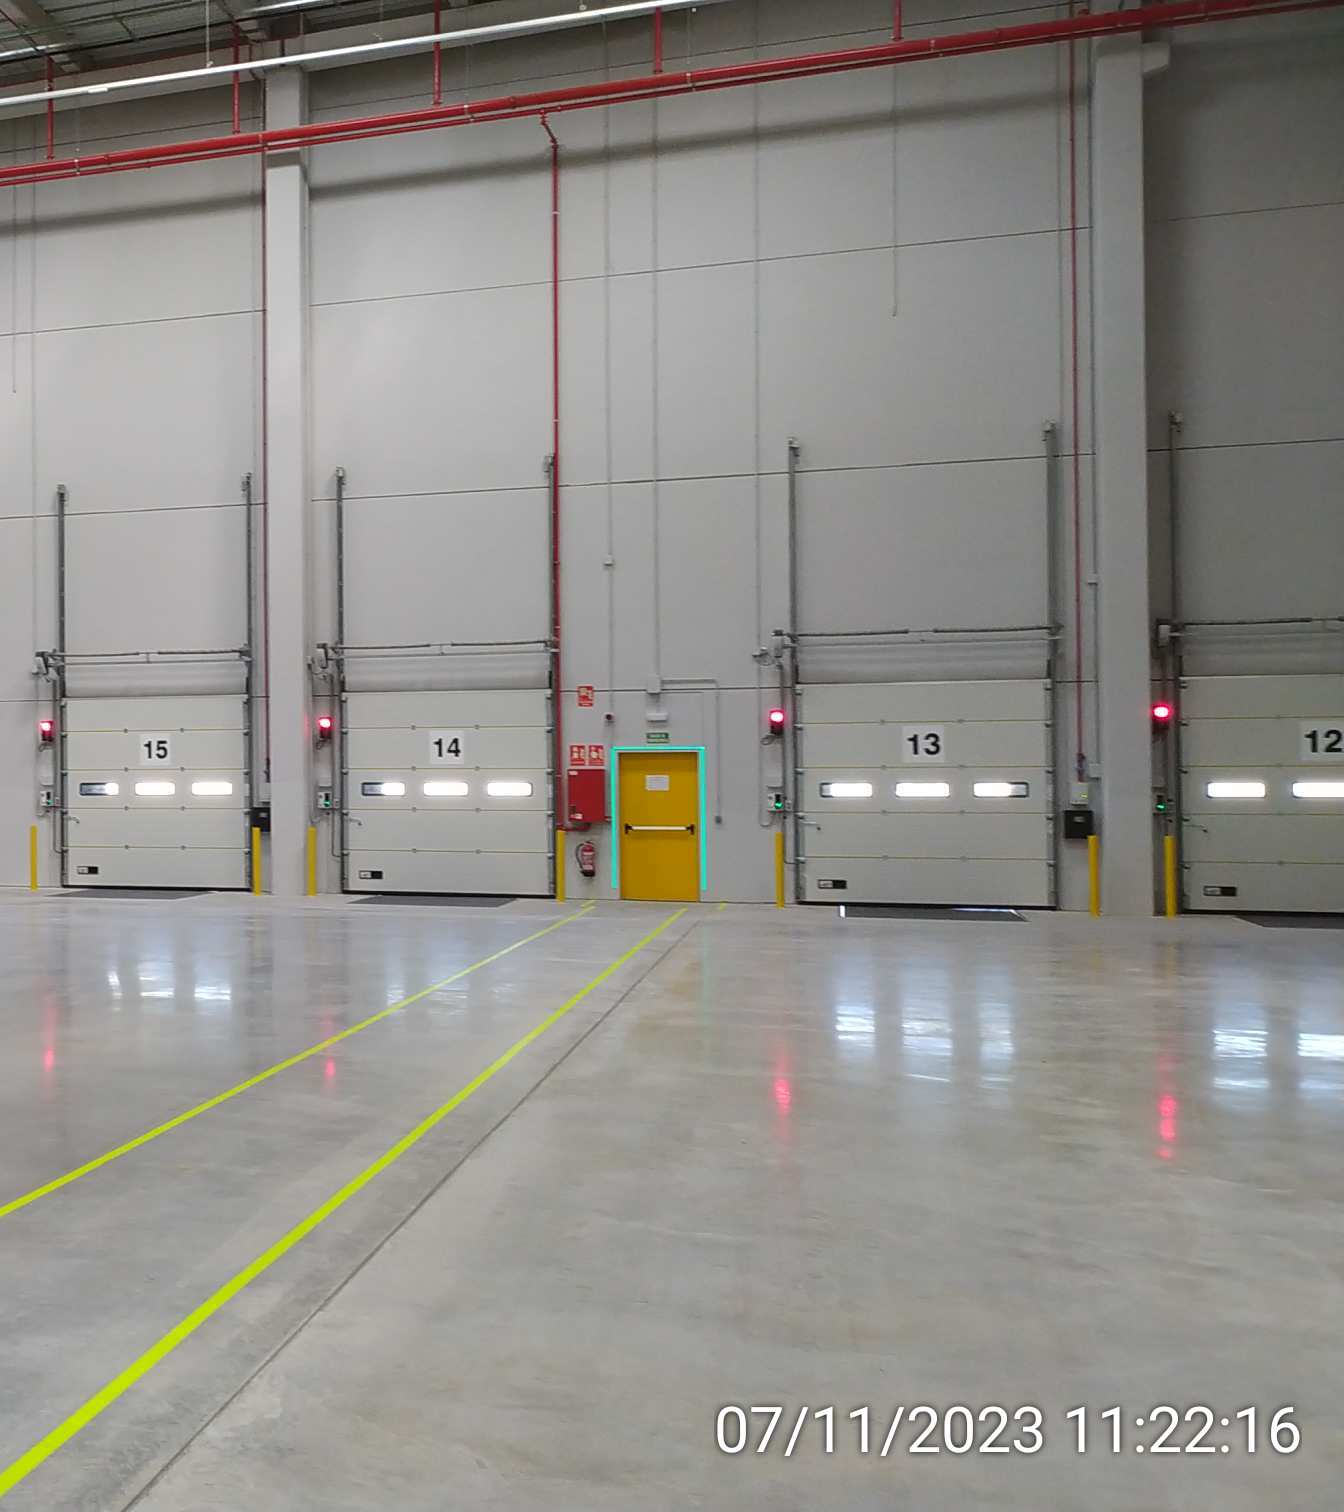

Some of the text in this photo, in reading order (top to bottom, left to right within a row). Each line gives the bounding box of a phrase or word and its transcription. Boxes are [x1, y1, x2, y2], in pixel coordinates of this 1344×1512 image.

[143, 740, 168, 759] 15
[433, 738, 462, 758] 14
[908, 733, 941, 755] 13
[1304, 730, 1343, 753] 12
